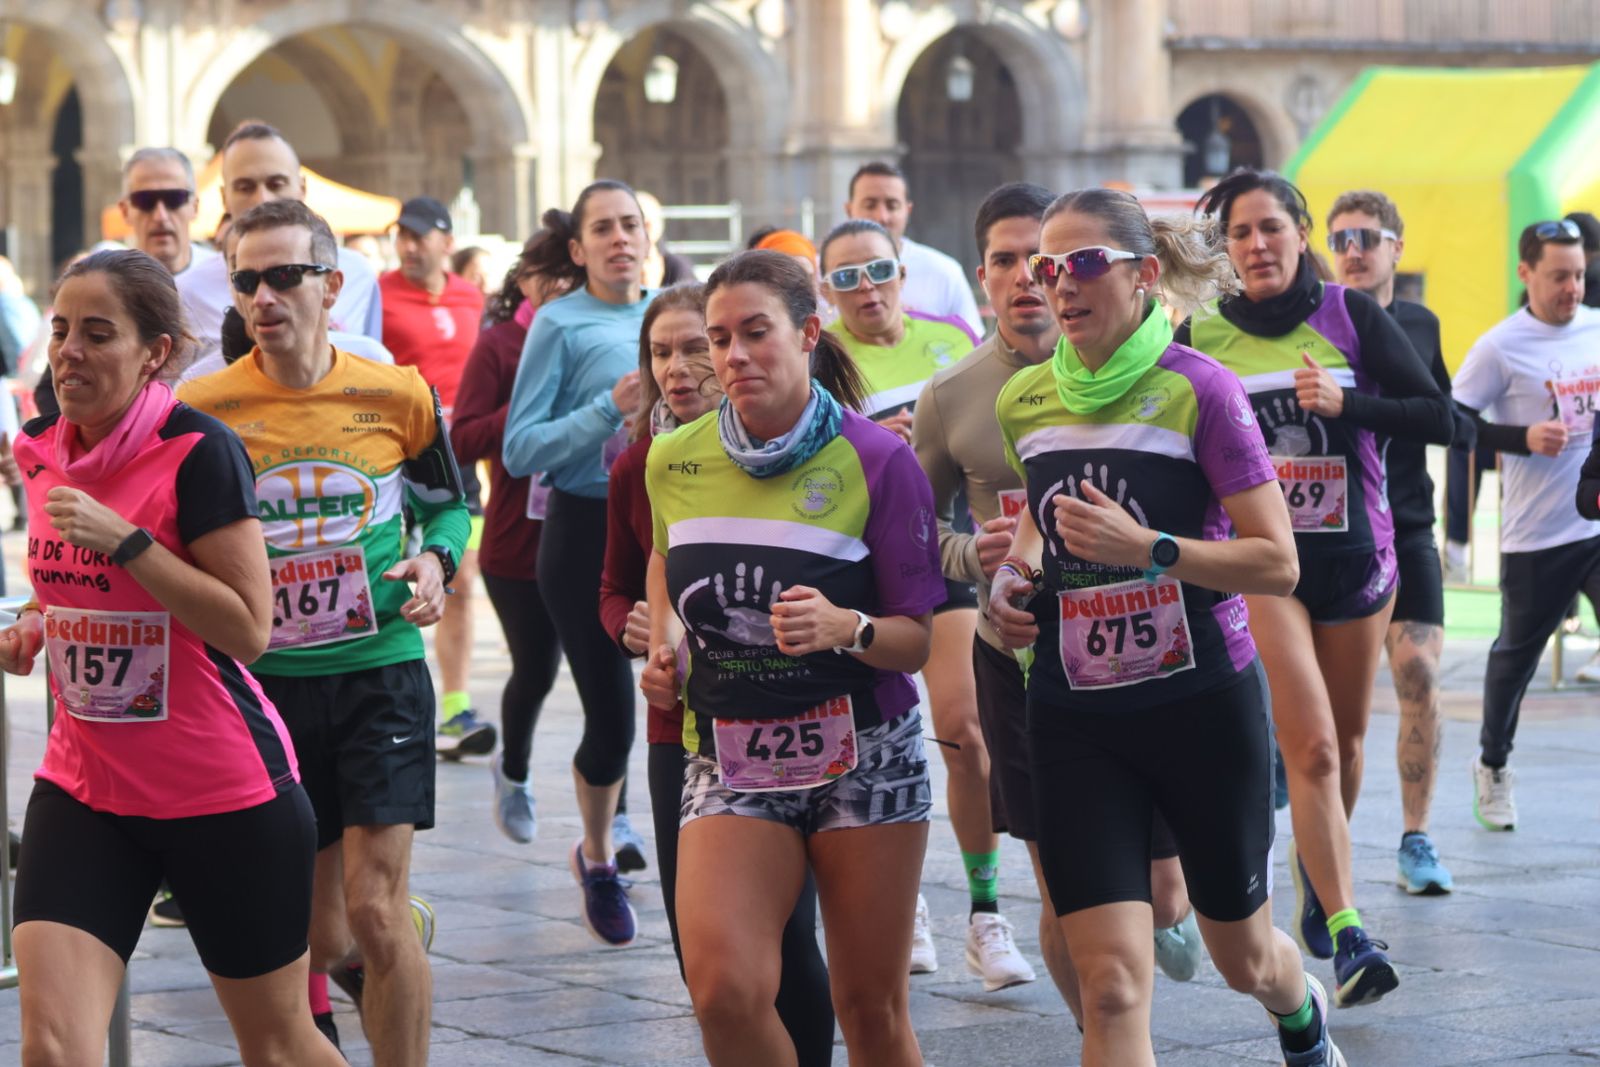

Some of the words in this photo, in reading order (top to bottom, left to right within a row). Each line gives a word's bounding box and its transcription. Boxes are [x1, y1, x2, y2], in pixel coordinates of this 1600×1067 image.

[282, 447, 378, 475] DEPORTIVO
[668, 460, 702, 475] EKT
[258, 493, 367, 522] ALCER
[1279, 482, 1325, 508] 69
[43, 540, 64, 561] DE
[33, 567, 111, 593] running
[275, 578, 340, 619] 167
[1062, 582, 1181, 620] bedunia
[1087, 612, 1157, 657] 675
[64, 645, 133, 687] 157
[746, 722, 824, 761] 425
